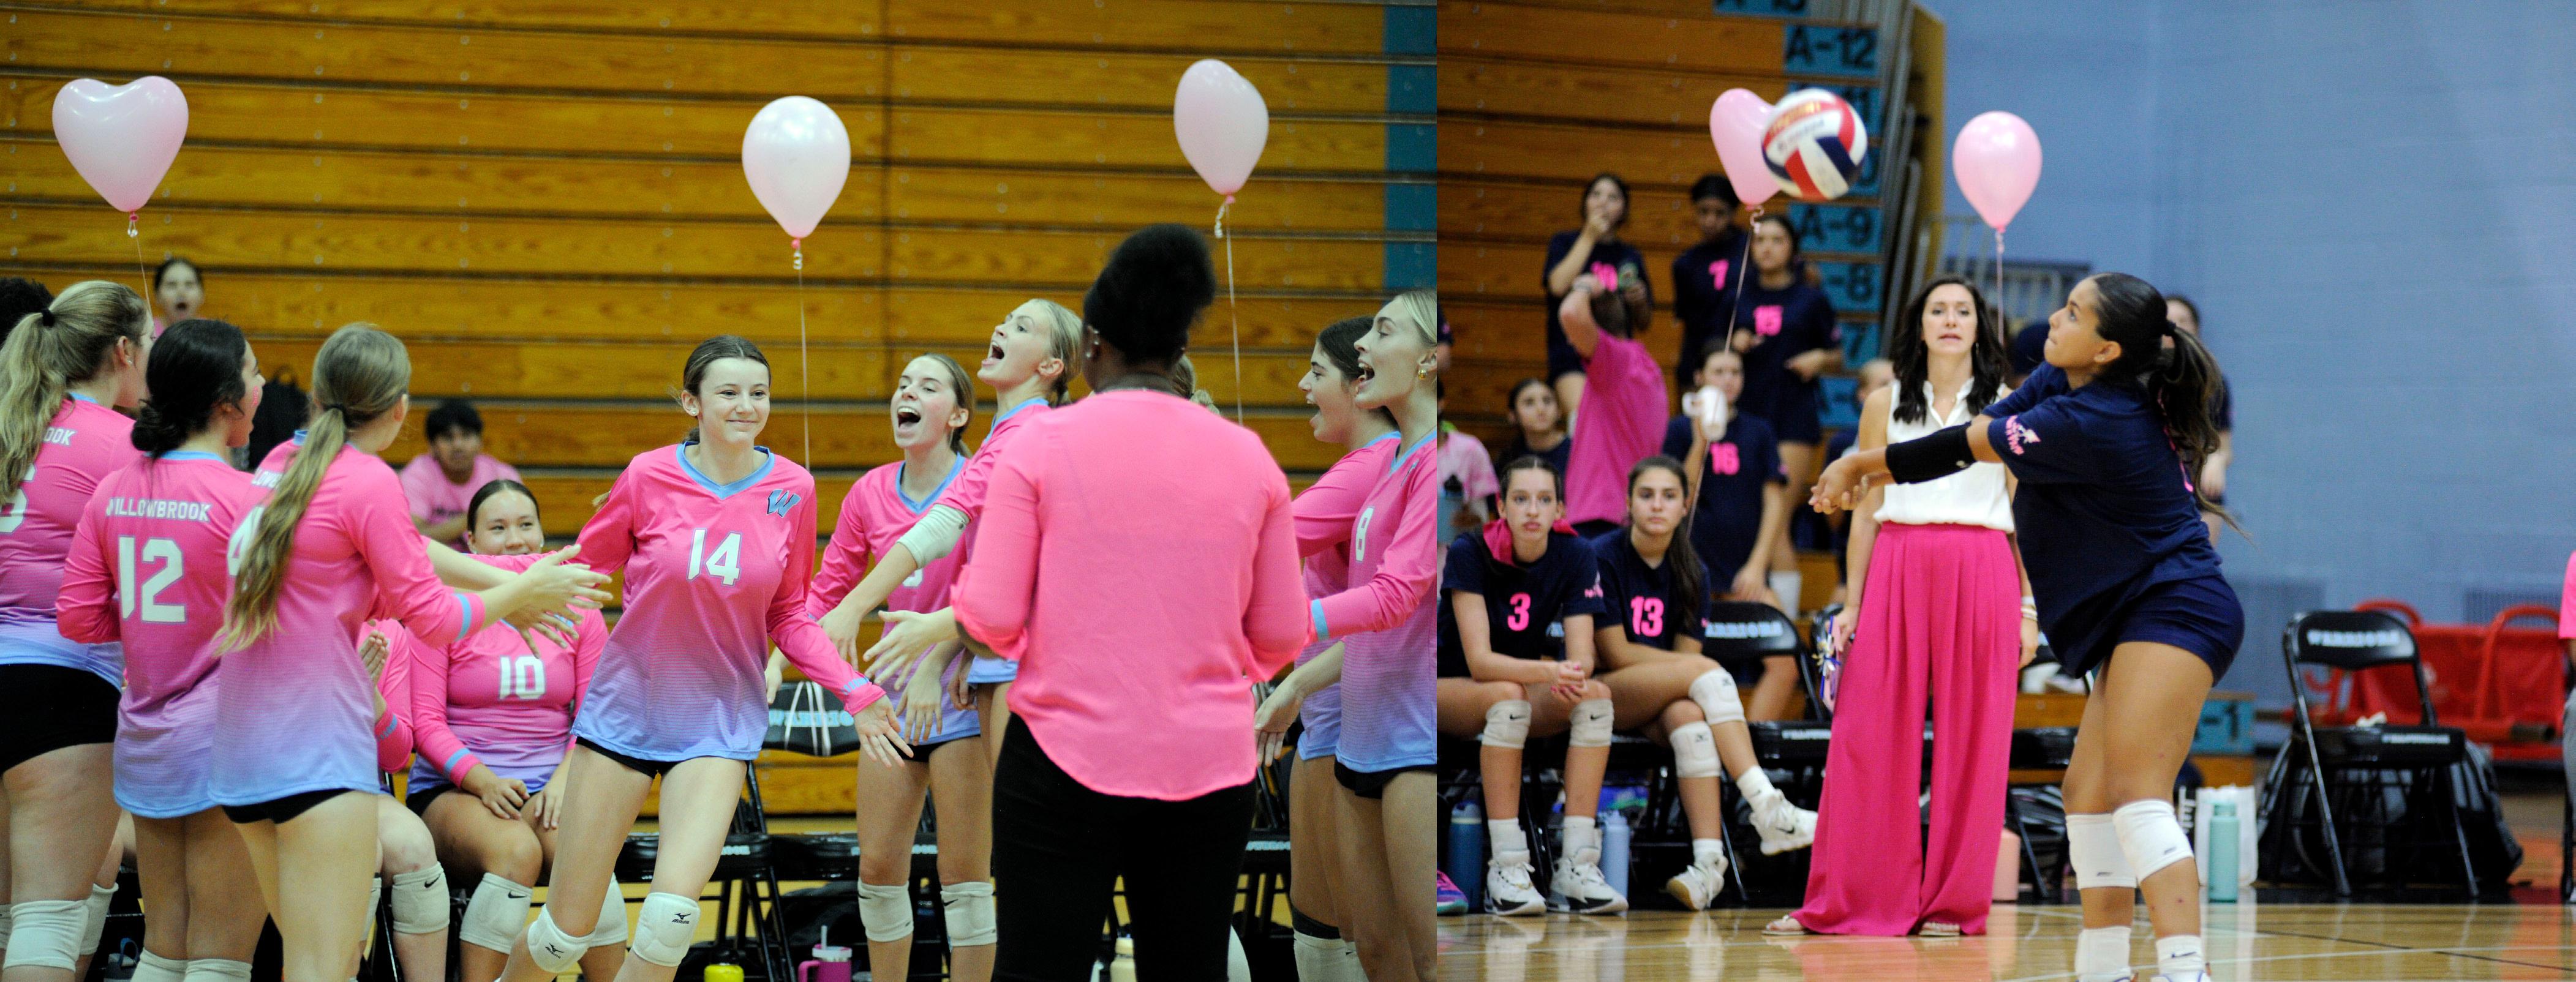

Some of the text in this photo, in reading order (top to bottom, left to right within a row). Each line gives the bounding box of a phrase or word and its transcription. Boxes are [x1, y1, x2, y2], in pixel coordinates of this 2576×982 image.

[1784, 24, 1877, 69] A-12
[1828, 263, 1872, 302] -8
[767, 489, 802, 518] W
[687, 528, 744, 586] 14
[118, 534, 187, 623] 12
[1507, 592, 1531, 631] 3
[1630, 596, 1664, 637] 13
[499, 655, 546, 700] 10
[2194, 700, 2239, 742] -1
